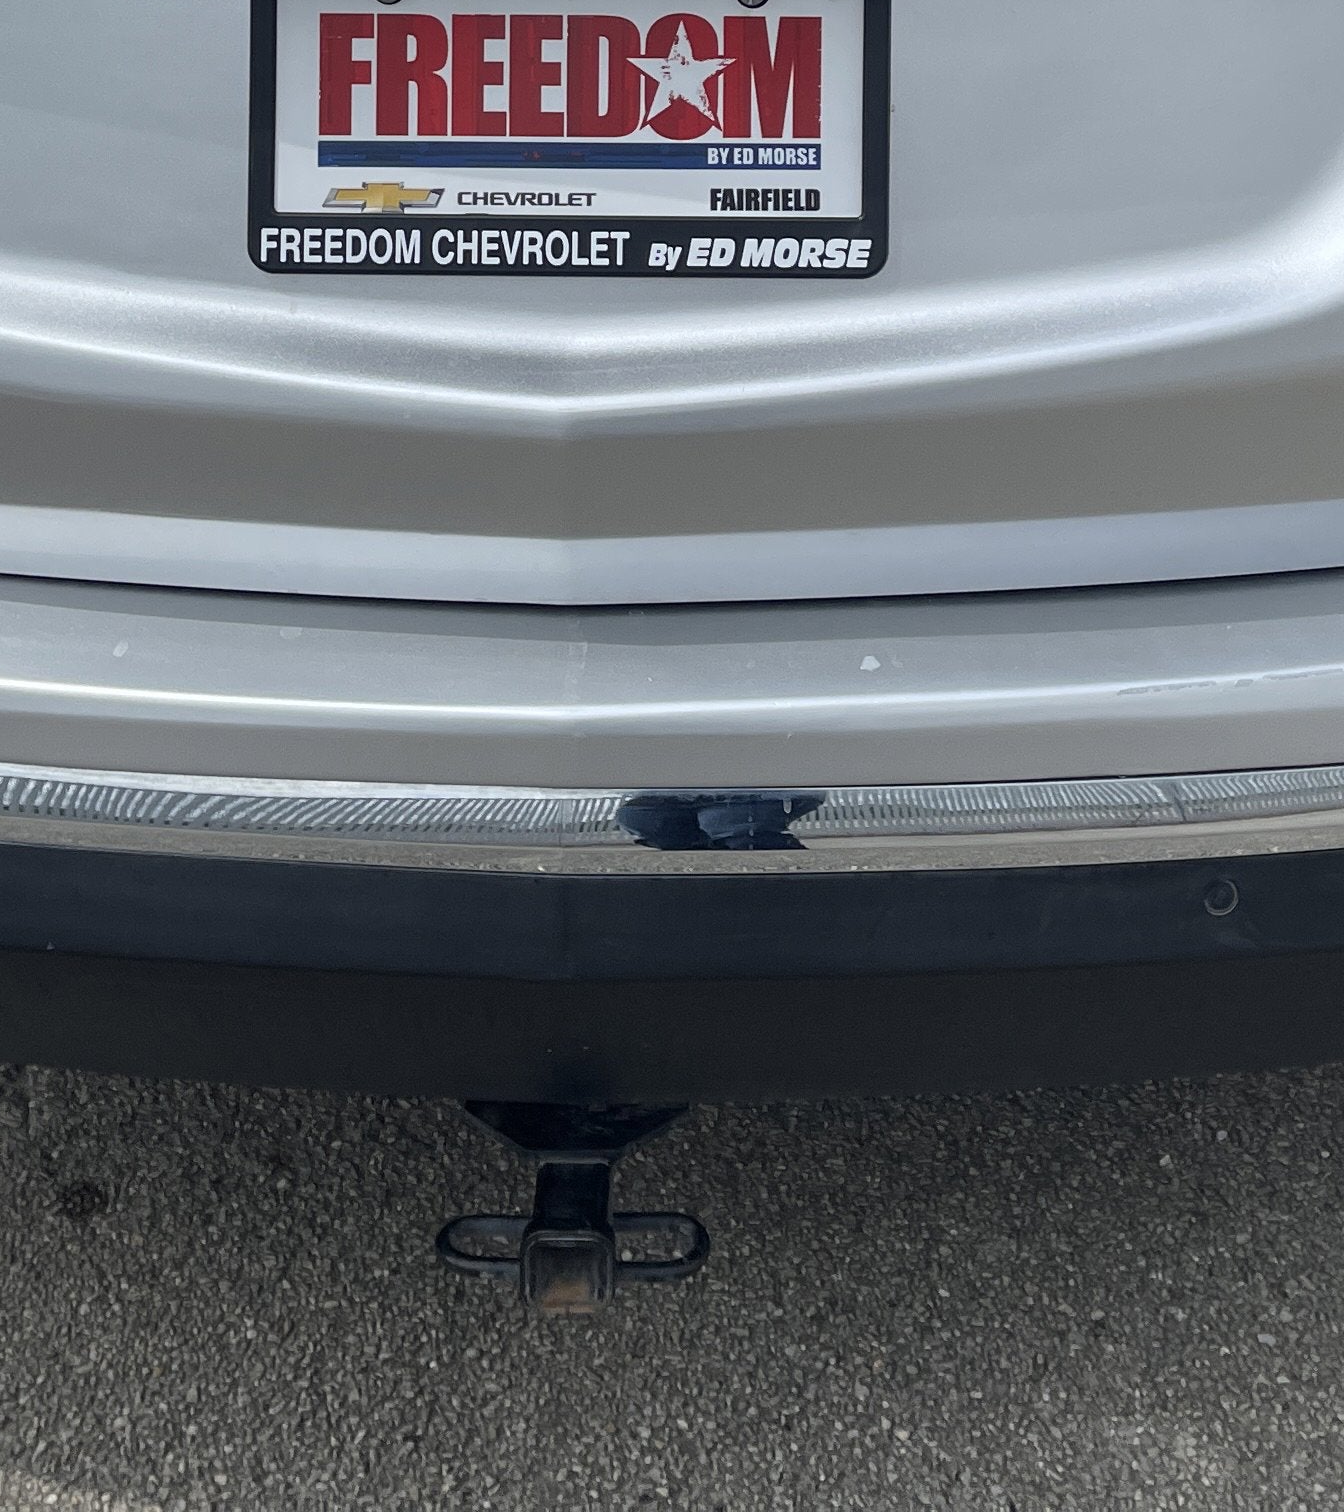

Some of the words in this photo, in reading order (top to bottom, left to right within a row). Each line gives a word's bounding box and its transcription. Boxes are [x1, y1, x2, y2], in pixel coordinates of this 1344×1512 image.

[318, 12, 823, 140] FREEDOM
[707, 147, 730, 165] BY
[733, 147, 754, 165] ED
[758, 147, 817, 165] MORSE
[457, 191, 597, 207] CHEVROLET
[710, 188, 821, 211] FAIRFIELD
[260, 227, 421, 265] FREEDOM
[431, 228, 630, 266] CHEVROLET
[648, 243, 682, 271] By
[686, 238, 736, 267] ED
[740, 238, 872, 269] MORSE
